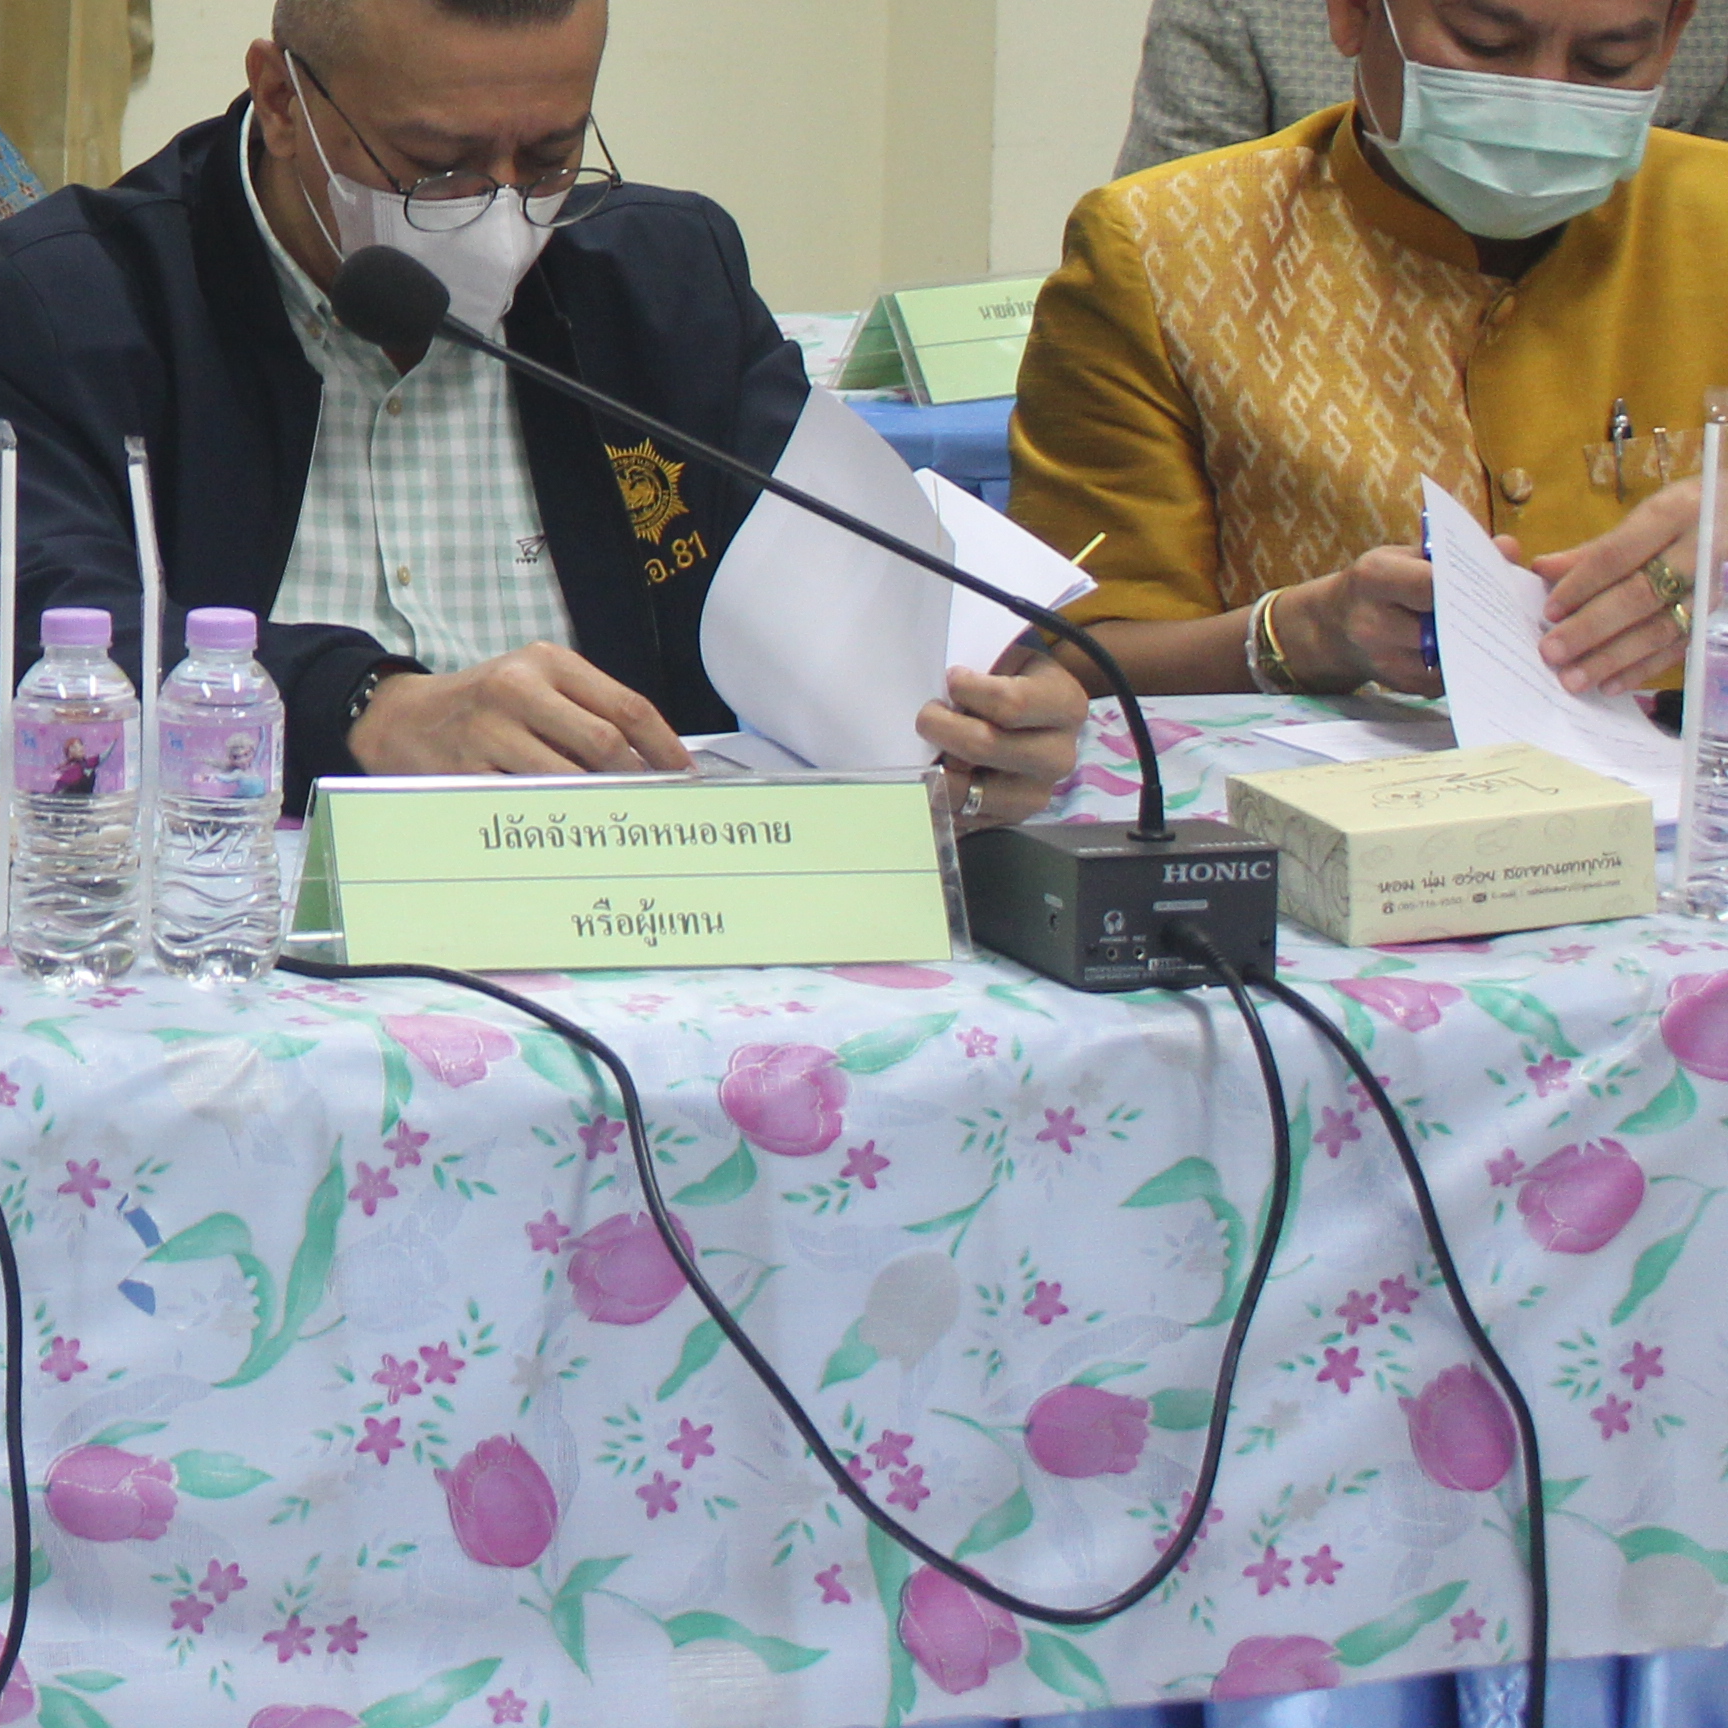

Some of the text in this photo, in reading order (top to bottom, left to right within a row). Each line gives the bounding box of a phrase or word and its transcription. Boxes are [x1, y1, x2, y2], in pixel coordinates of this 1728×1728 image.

[478, 811, 793, 851] ปลัดจังหวัดหนองคาย
[570, 896, 726, 948] หรือผู้แทน
